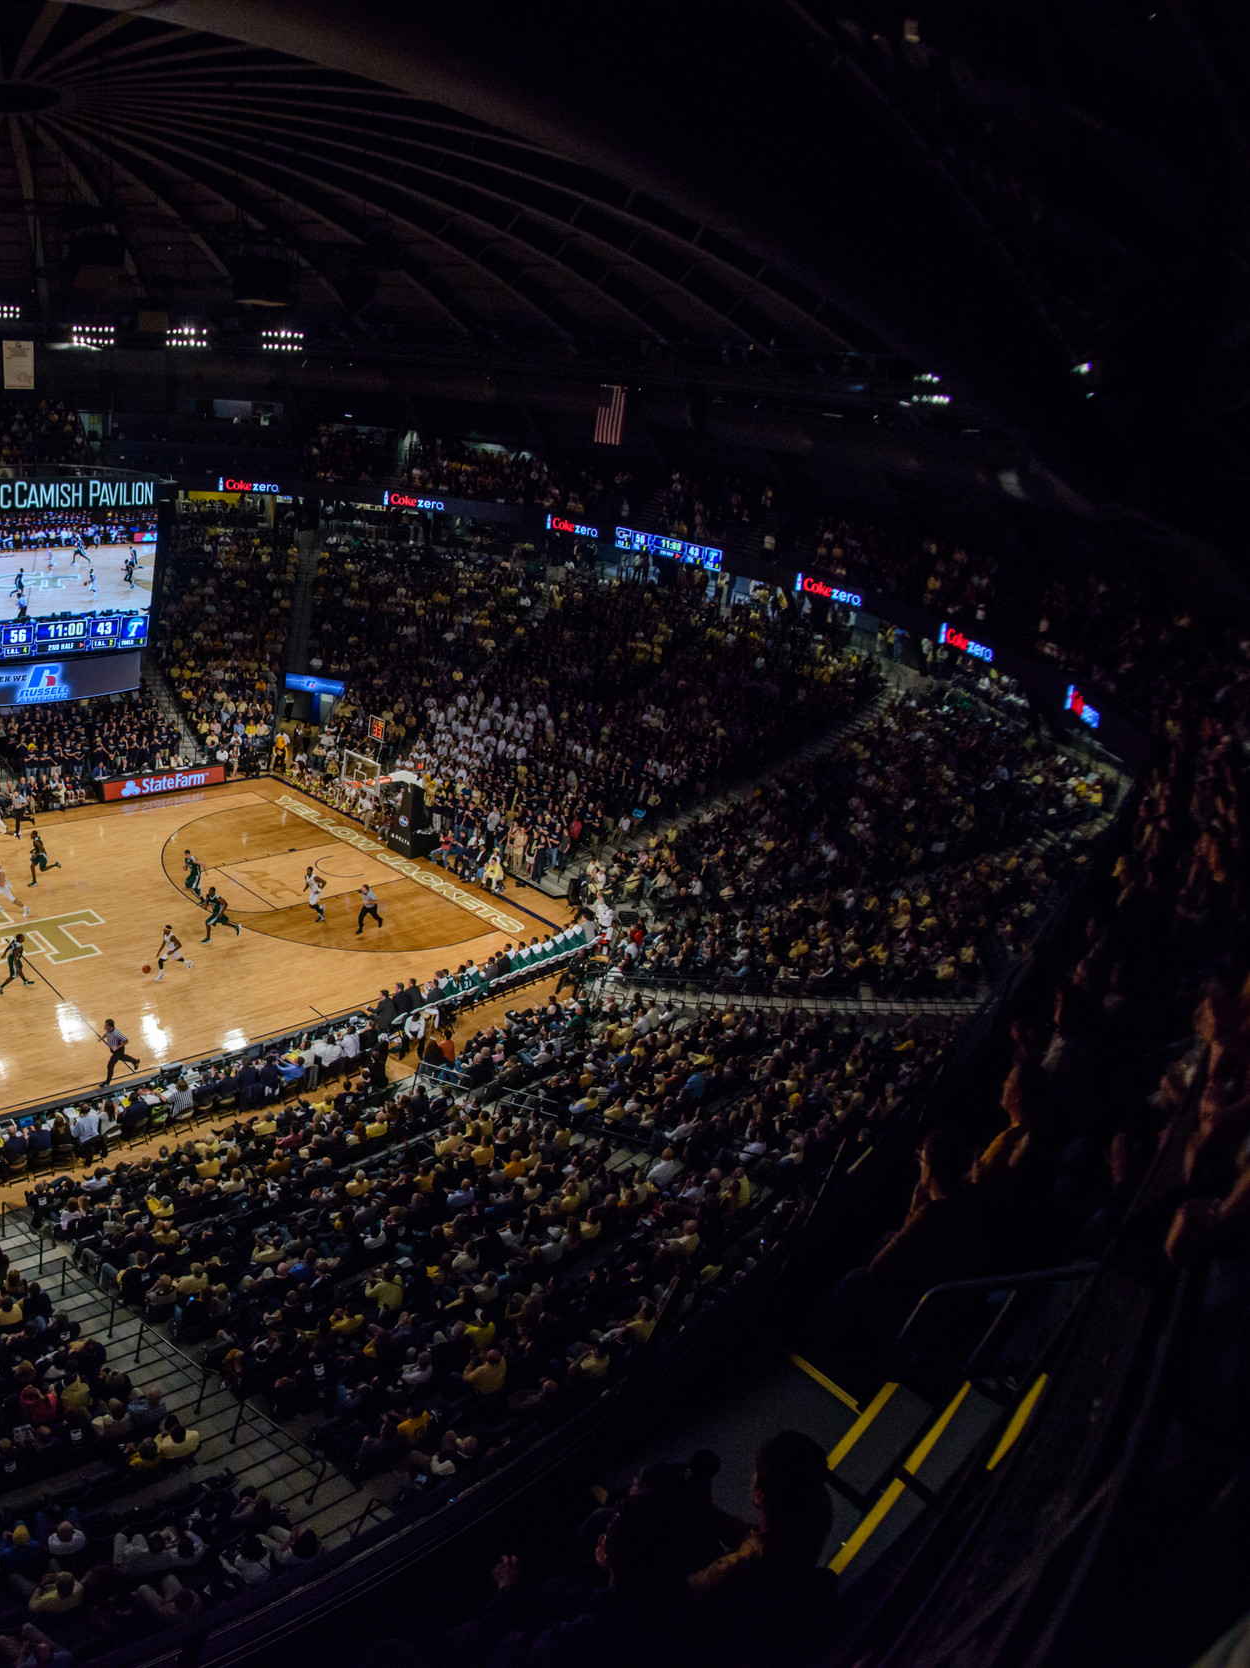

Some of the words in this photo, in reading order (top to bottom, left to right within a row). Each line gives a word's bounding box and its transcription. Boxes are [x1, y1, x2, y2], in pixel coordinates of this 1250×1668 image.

[89, 480, 154, 507] PAVILION
[225, 479, 252, 491] Coke
[252, 483, 279, 493] zero
[390, 493, 417, 507] Coke
[417, 499, 445, 511] zero
[552, 517, 575, 533] Coke
[574, 524, 599, 538] zero
[803, 577, 832, 597] Coke
[830, 588, 862, 607] zero
[10, 629, 27, 643] 56
[48, 622, 84, 638] 11:00
[96, 622, 112, 635] 43
[12, 674, 27, 682] WE
[17, 685, 69, 698] RUSSELL
[372, 725, 382, 739] 33
[395, 834, 410, 846] DELTA
[275, 795, 385, 851] YELLOW
[376, 853, 525, 933] JACKETS
[236, 869, 302, 899] ACC
